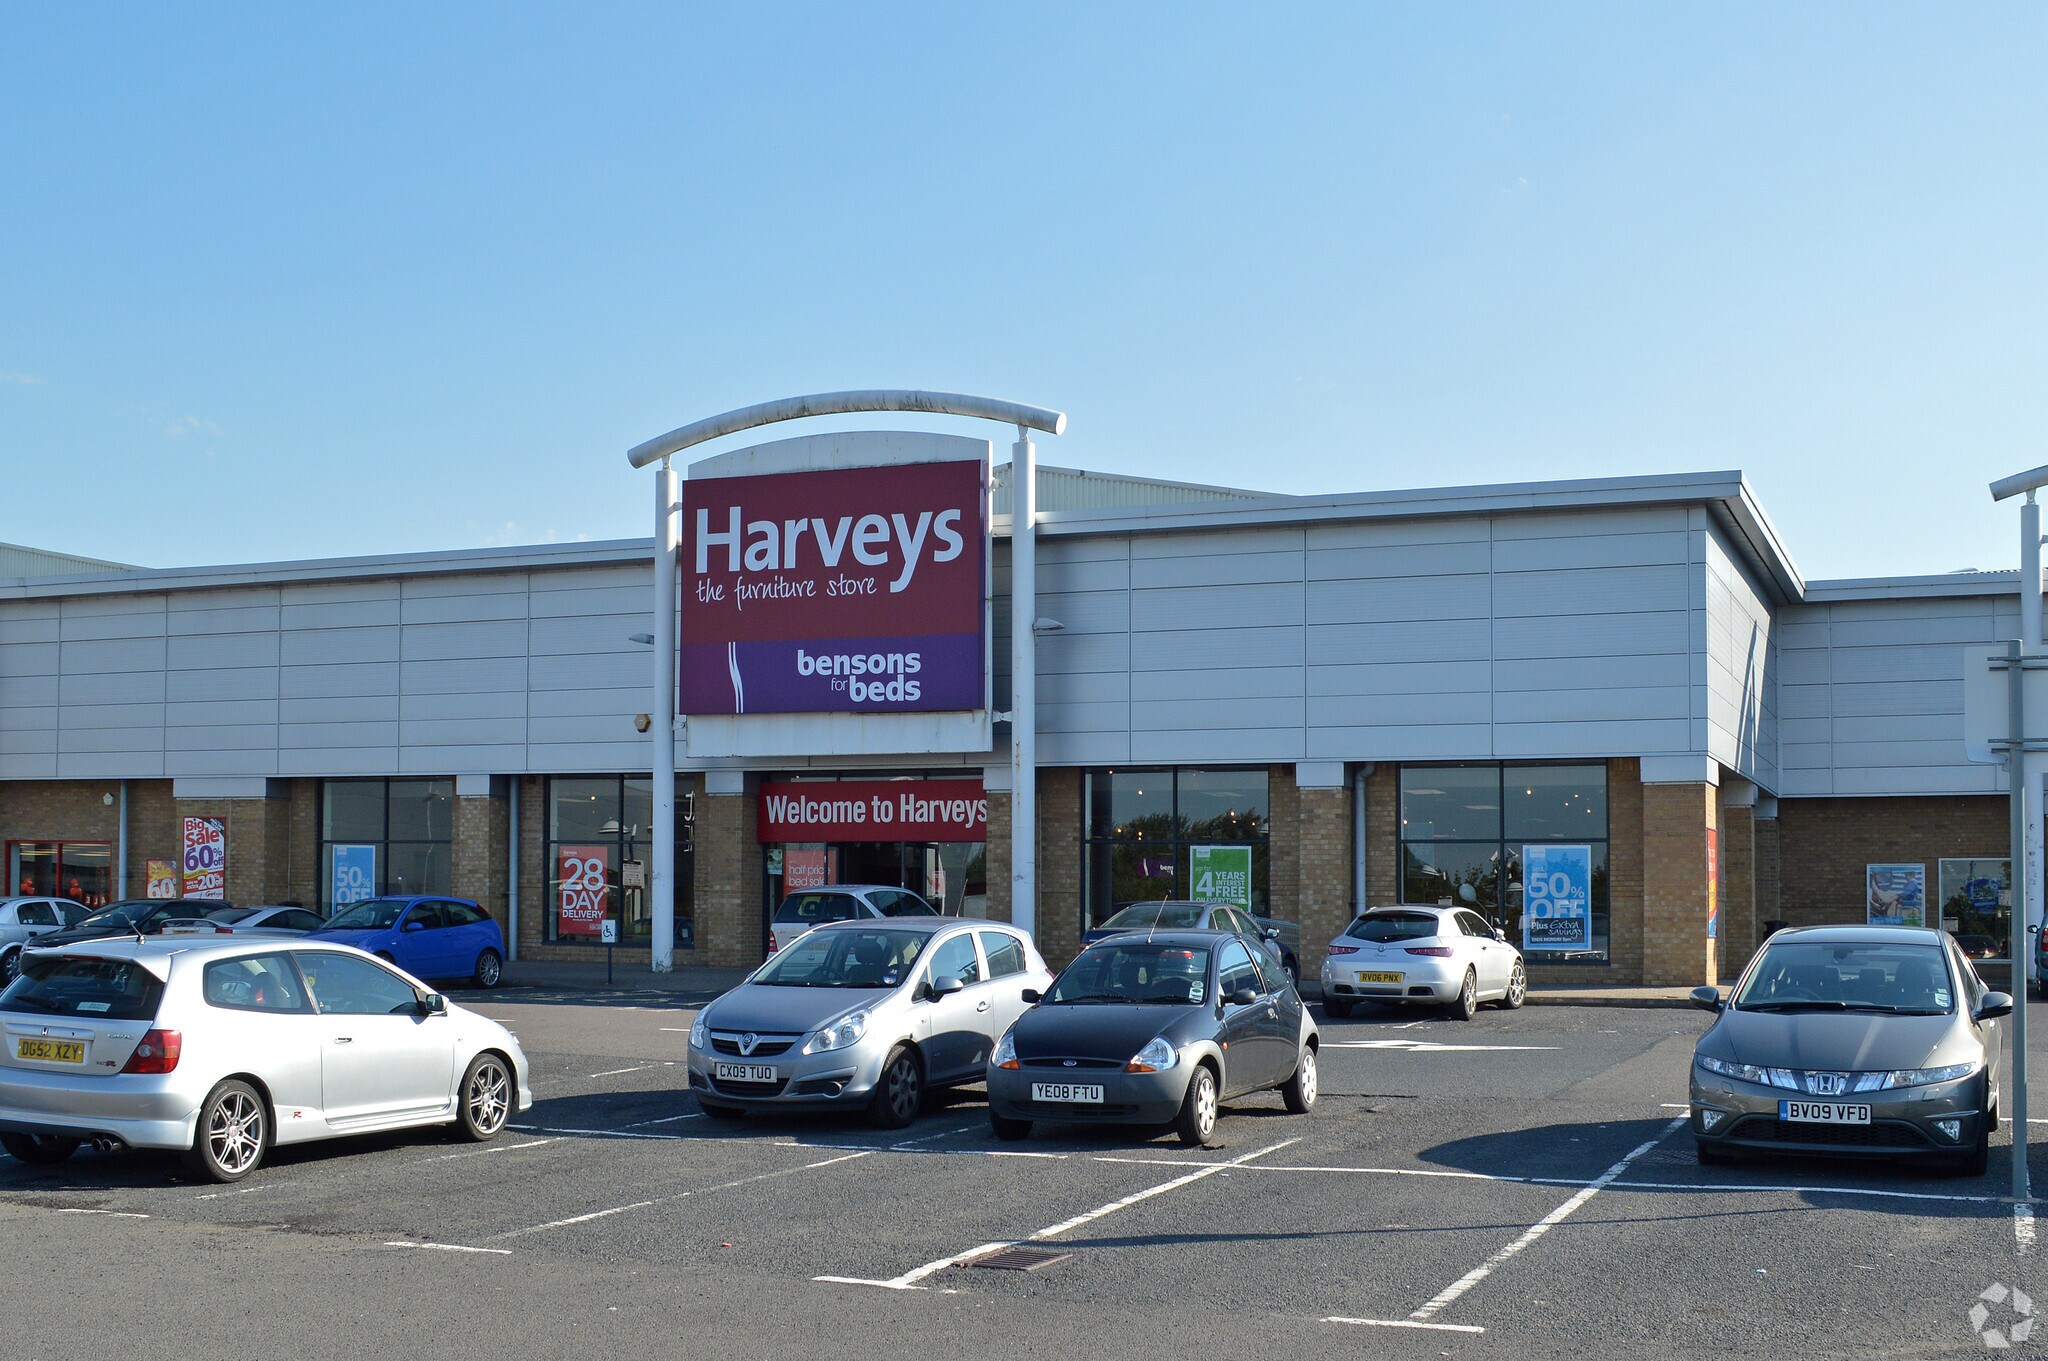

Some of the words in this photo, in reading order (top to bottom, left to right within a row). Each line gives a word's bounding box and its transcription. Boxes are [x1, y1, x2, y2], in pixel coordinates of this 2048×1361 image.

[695, 506, 964, 593] Harveys
[696, 577, 725, 604] the
[734, 575, 816, 611] furniture
[826, 573, 877, 597] store
[797, 649, 921, 676] bensons
[831, 677, 848, 692] for
[849, 674, 921, 702] beds
[766, 795, 866, 824] Welcome
[871, 795, 894, 823] to
[900, 794, 987, 828] Harveys
[186, 818, 205, 832] Big
[213, 856, 224, 866] off
[788, 864, 807, 875] half
[337, 866, 371, 888] 50%
[563, 858, 604, 891] 28
[788, 876, 808, 887] bed
[1215, 871, 1245, 880] YEARS
[1196, 871, 1215, 897] 4
[1216, 886, 1245, 897] FREE
[1529, 872, 1585, 898] 50%
[337, 887, 371, 903] OFF
[563, 891, 604, 910] DAY
[562, 909, 604, 919] DELIVERY
[1529, 898, 1585, 918] OFF
[1531, 921, 1548, 930] Plus
[1549, 919, 1580, 929] Extra
[1383, 974, 1399, 982] PNX
[22, 1041, 52, 1057] DG52
[55, 1044, 80, 1059] XZY
[720, 1065, 746, 1078] CX09
[749, 1066, 772, 1079] TUO
[1037, 1084, 1070, 1099] YE08
[1073, 1086, 1099, 1100] FTU
[1790, 1103, 1832, 1119] BV09
[1837, 1105, 1868, 1121] VFD
